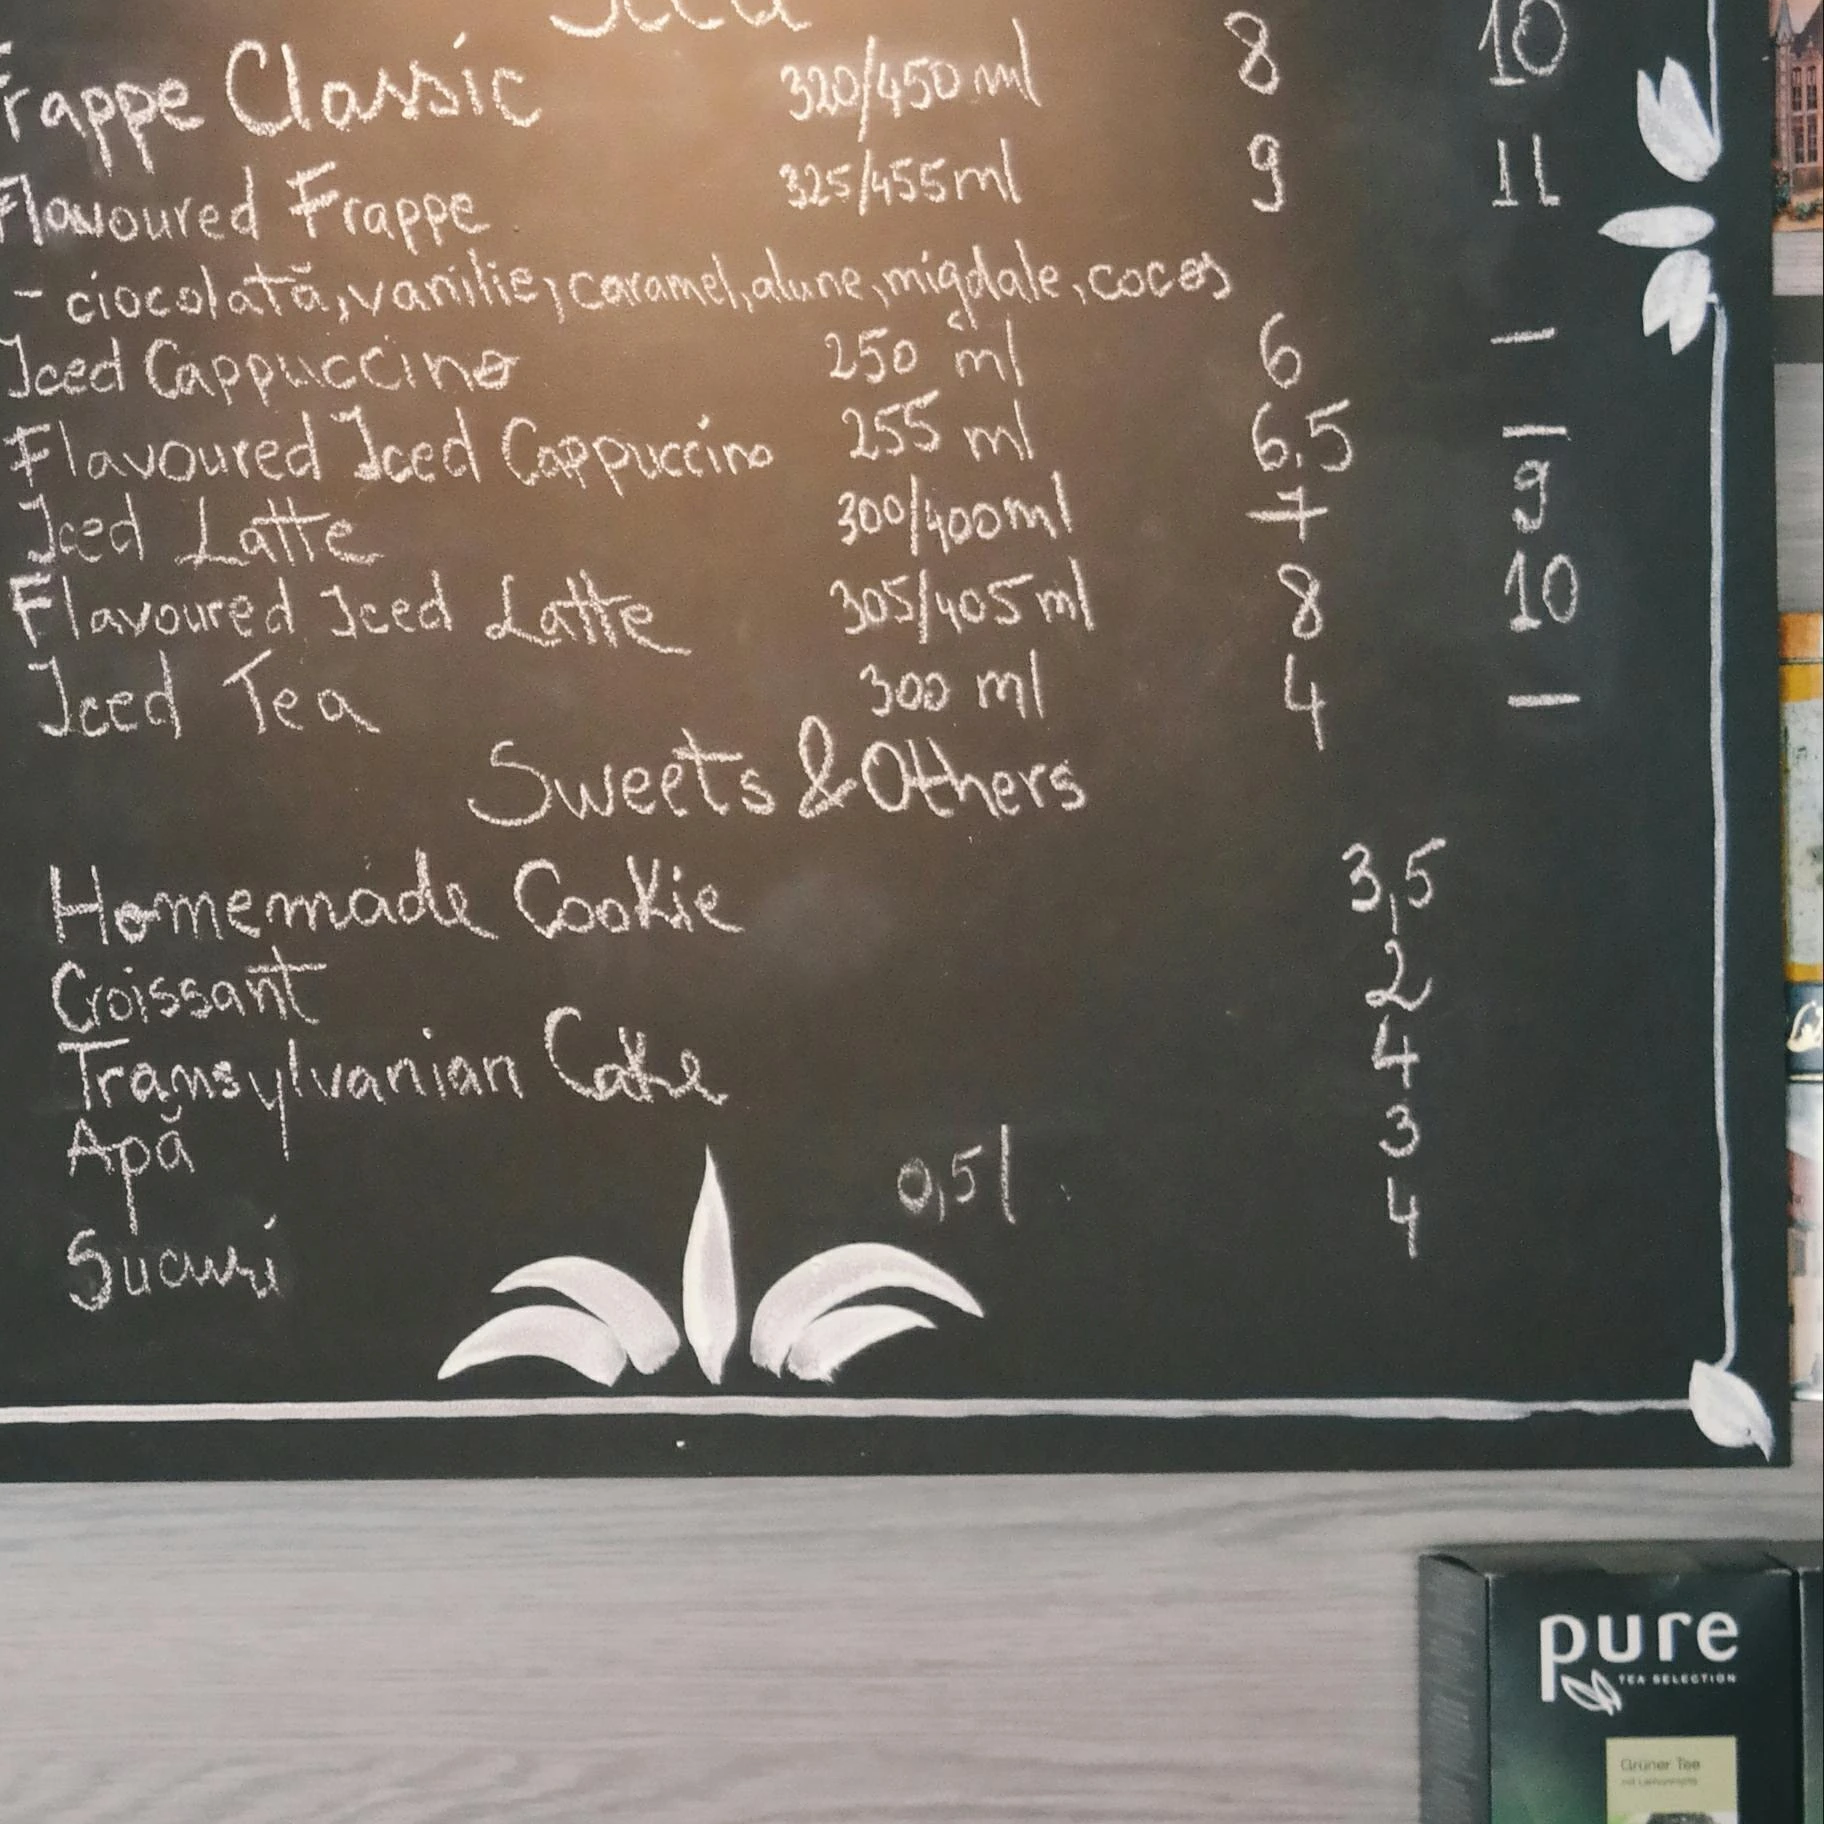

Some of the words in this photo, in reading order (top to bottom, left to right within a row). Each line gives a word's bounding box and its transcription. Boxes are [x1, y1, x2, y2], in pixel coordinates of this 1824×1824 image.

[224, 31, 543, 138] Classic
[780, 34, 961, 144] 320/450
[973, 17, 1043, 107] ml
[1222, 9, 1281, 95] 8
[286, 161, 491, 256] Frappe
[1248, 133, 1285, 214] 9
[1491, 133, 1562, 207] 11
[145, 334, 521, 407] Cappuccino
[825, 327, 917, 383] 250
[954, 318, 1024, 387] ml
[1259, 312, 1302, 390] 6
[3, 411, 323, 487] Flavoured
[331, 407, 482, 484] Iced
[501, 414, 774, 498] Cappuccino
[841, 388, 941, 461] 255
[963, 398, 1034, 462] ml
[18, 493, 146, 564] Iced
[176, 496, 385, 568] Latte
[1245, 485, 1330, 544] 7
[1512, 459, 1551, 534] 9
[6, 574, 295, 649] Flavoured
[321, 569, 454, 638] Iced
[485, 569, 693, 656] Latte
[1277, 562, 1324, 640] 8
[1504, 549, 1578, 633] 10
[29, 650, 183, 740] Iced
[222, 648, 381, 735] Tea
[859, 663, 951, 718] 300
[976, 648, 1045, 720] ml
[1283, 653, 1327, 752] 4
[466, 729, 776, 827] Sweets
[48, 848, 499, 945] Homemade
[512, 855, 746, 940] Cookie
[1342, 837, 1447, 935] 3,5
[1364, 939, 1433, 1012] 2
[56, 1028, 526, 1161] Transylvanian
[542, 1006, 730, 1106] Cake
[1370, 1014, 1420, 1091] 4
[66, 1104, 195, 1237] Apă
[1379, 1104, 1419, 1158] 3
[1386, 1176, 1420, 1259] 4
[1539, 1611, 1739, 1703] pure
[1619, 1674, 1645, 1685] TEA
[1652, 1673, 1736, 1686] SELECTION
